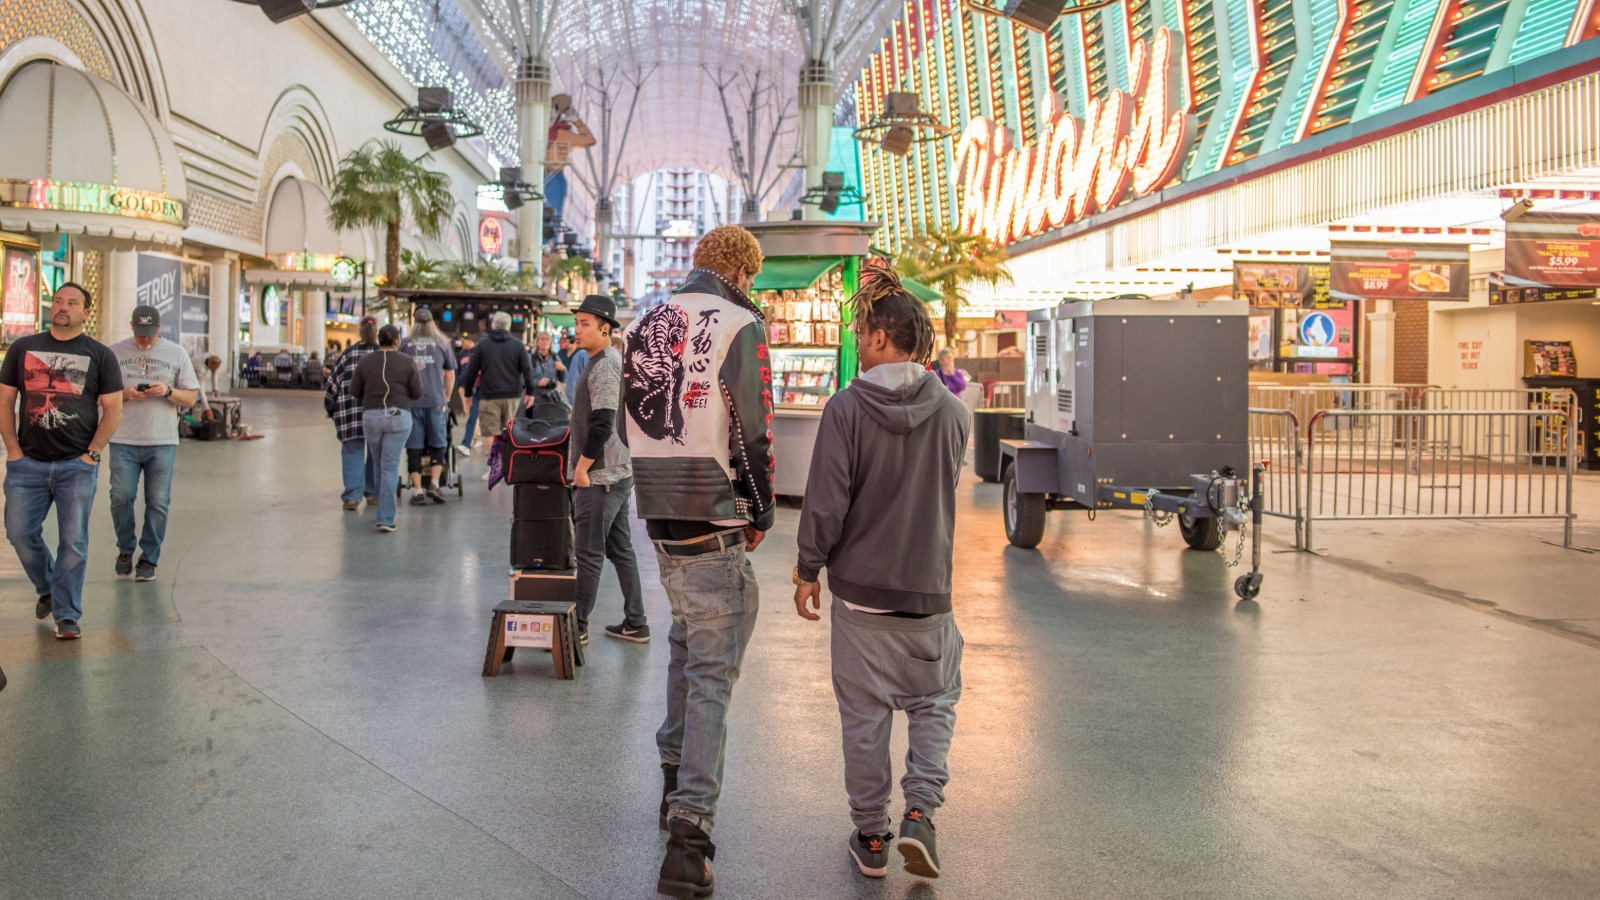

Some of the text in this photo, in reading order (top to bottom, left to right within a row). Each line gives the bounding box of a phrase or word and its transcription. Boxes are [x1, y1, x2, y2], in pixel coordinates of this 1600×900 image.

[109, 194, 178, 215] GOLDEN
[1549, 256, 1579, 266] $5.99
[137, 268, 177, 306] TROY
[1363, 280, 1389, 290] $8.99
[689, 308, 721, 374] 不動心
[1458, 340, 1483, 350] FIRE EXIT
[1461, 351, 1480, 360] DO NOT
[119, 357, 171, 370] HARLEY-DAVIDSON
[1462, 361, 1479, 370] BLOCK
[686, 380, 711, 391] YOUNG
[683, 398, 708, 410] FREE!
